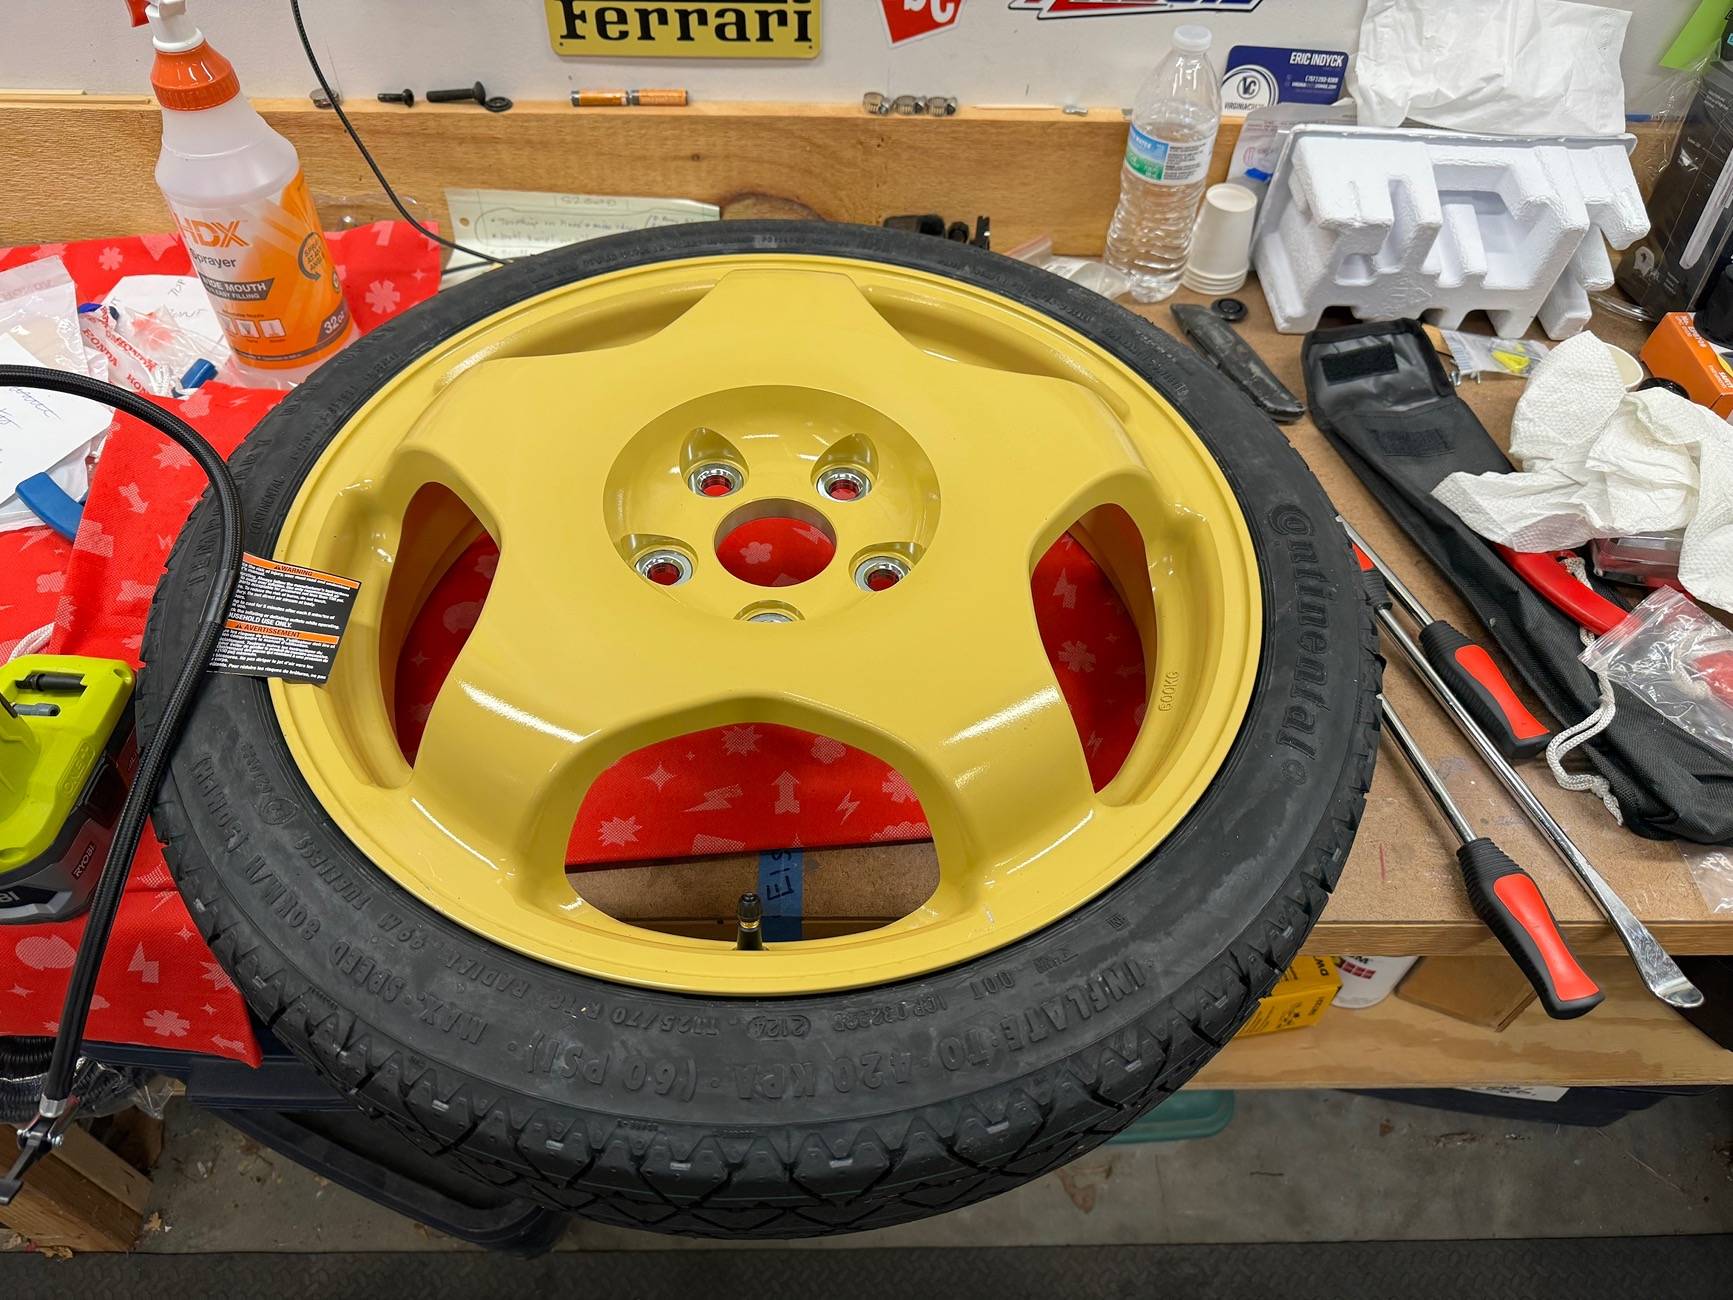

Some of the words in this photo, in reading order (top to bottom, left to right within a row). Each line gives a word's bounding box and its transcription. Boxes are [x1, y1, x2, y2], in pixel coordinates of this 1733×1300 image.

[559, 0, 813, 42] Ferrari
[1290, 52, 1311, 65] ERIC
[1310, 53, 1344, 67] INDYCK
[224, 283, 267, 293] MOUTH
[323, 316, 338, 334] 32
[281, 565, 313, 577] WARNING
[228, 613, 261, 623] USEHOLD
[261, 617, 274, 625] USE
[243, 624, 301, 638] AVERTISSEMENT
[74, 845, 96, 879] RYOBI
[329, 941, 408, 1003] SPEED
[1001, 958, 1147, 1053] INFLATE
[938, 1026, 992, 1072] TO
[732, 1062, 818, 1101] KPA
[831, 1051, 914, 1095] 420
